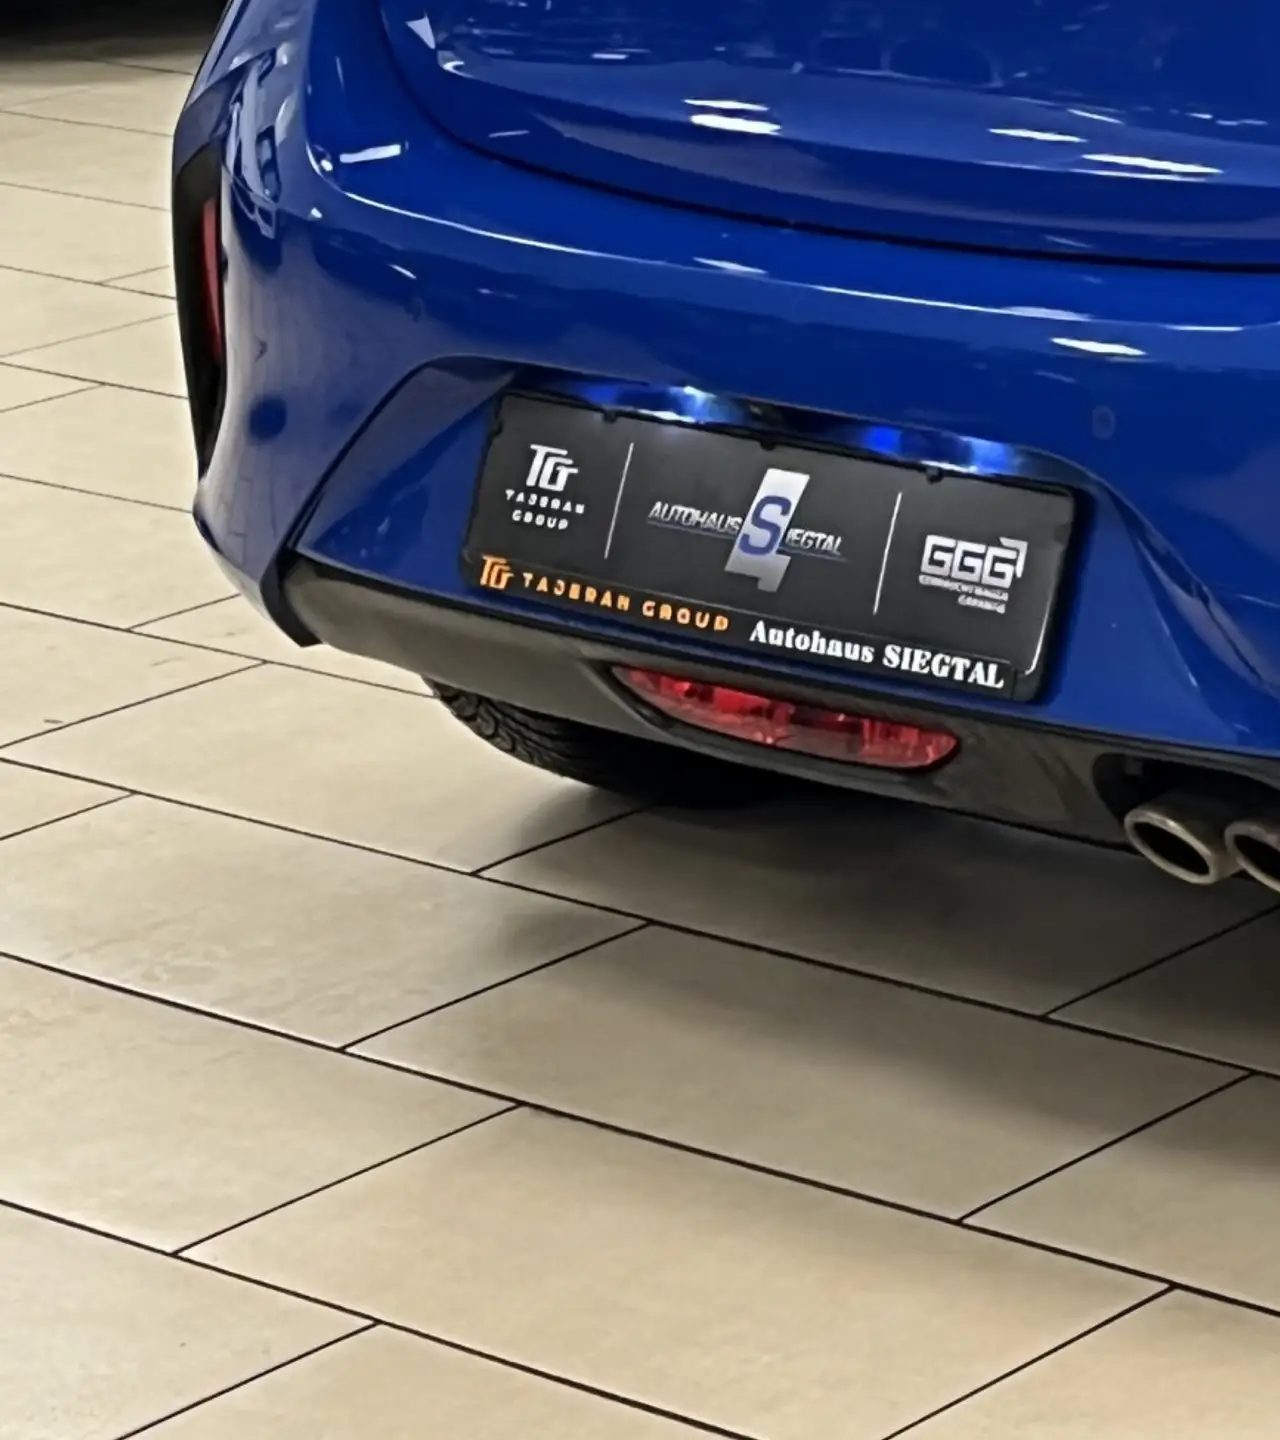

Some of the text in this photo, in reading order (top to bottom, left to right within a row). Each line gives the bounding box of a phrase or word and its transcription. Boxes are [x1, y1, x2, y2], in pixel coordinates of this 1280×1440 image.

[648, 501, 743, 535] AUTOHAUS
[921, 535, 1022, 588] GGG
[642, 600, 730, 632] GROUP
[749, 620, 1005, 689] Autohaus SIEGTAL
